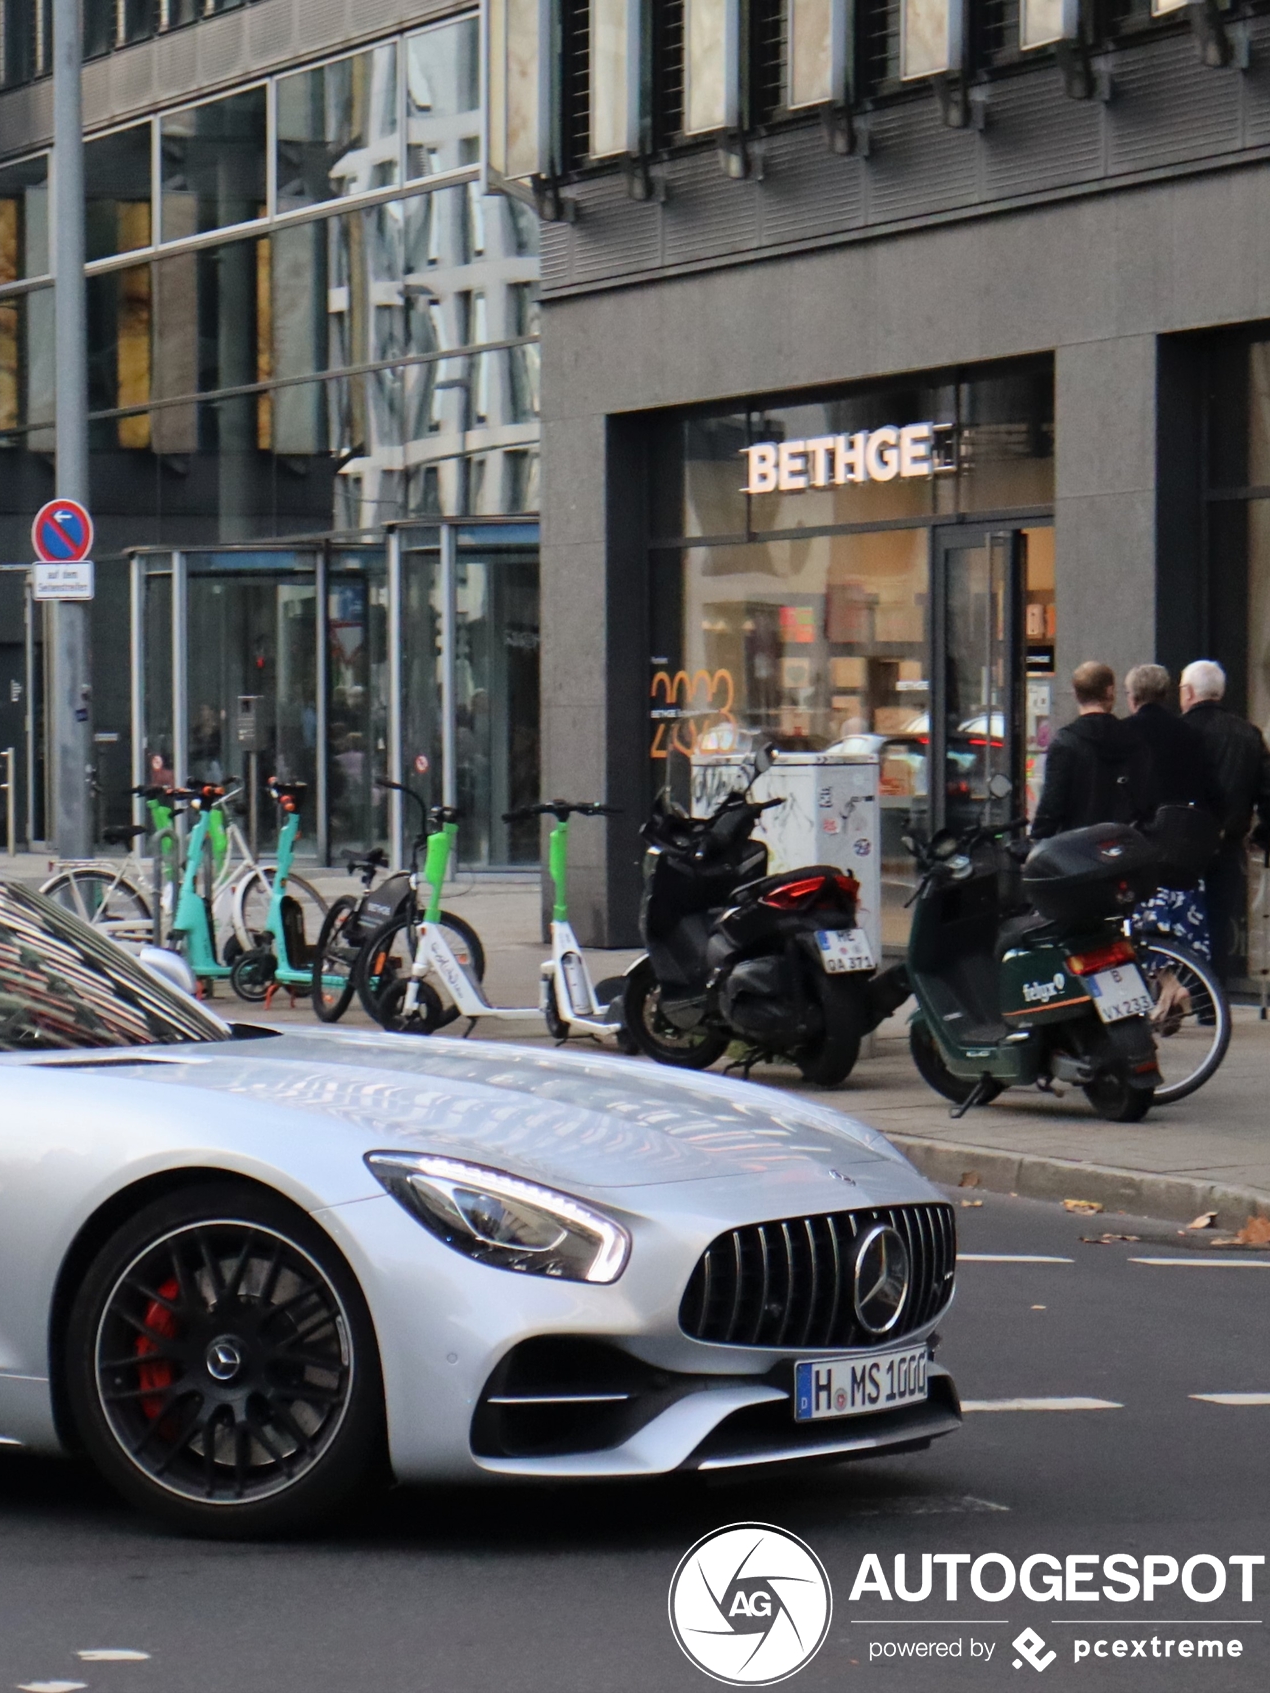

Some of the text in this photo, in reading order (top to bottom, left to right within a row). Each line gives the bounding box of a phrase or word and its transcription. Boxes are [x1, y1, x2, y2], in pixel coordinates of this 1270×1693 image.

[748, 422, 933, 494] BETHGE
[1111, 970, 1123, 983] B
[1122, 995, 1150, 1014] 233
[814, 1352, 927, 1411] H MS 1000
